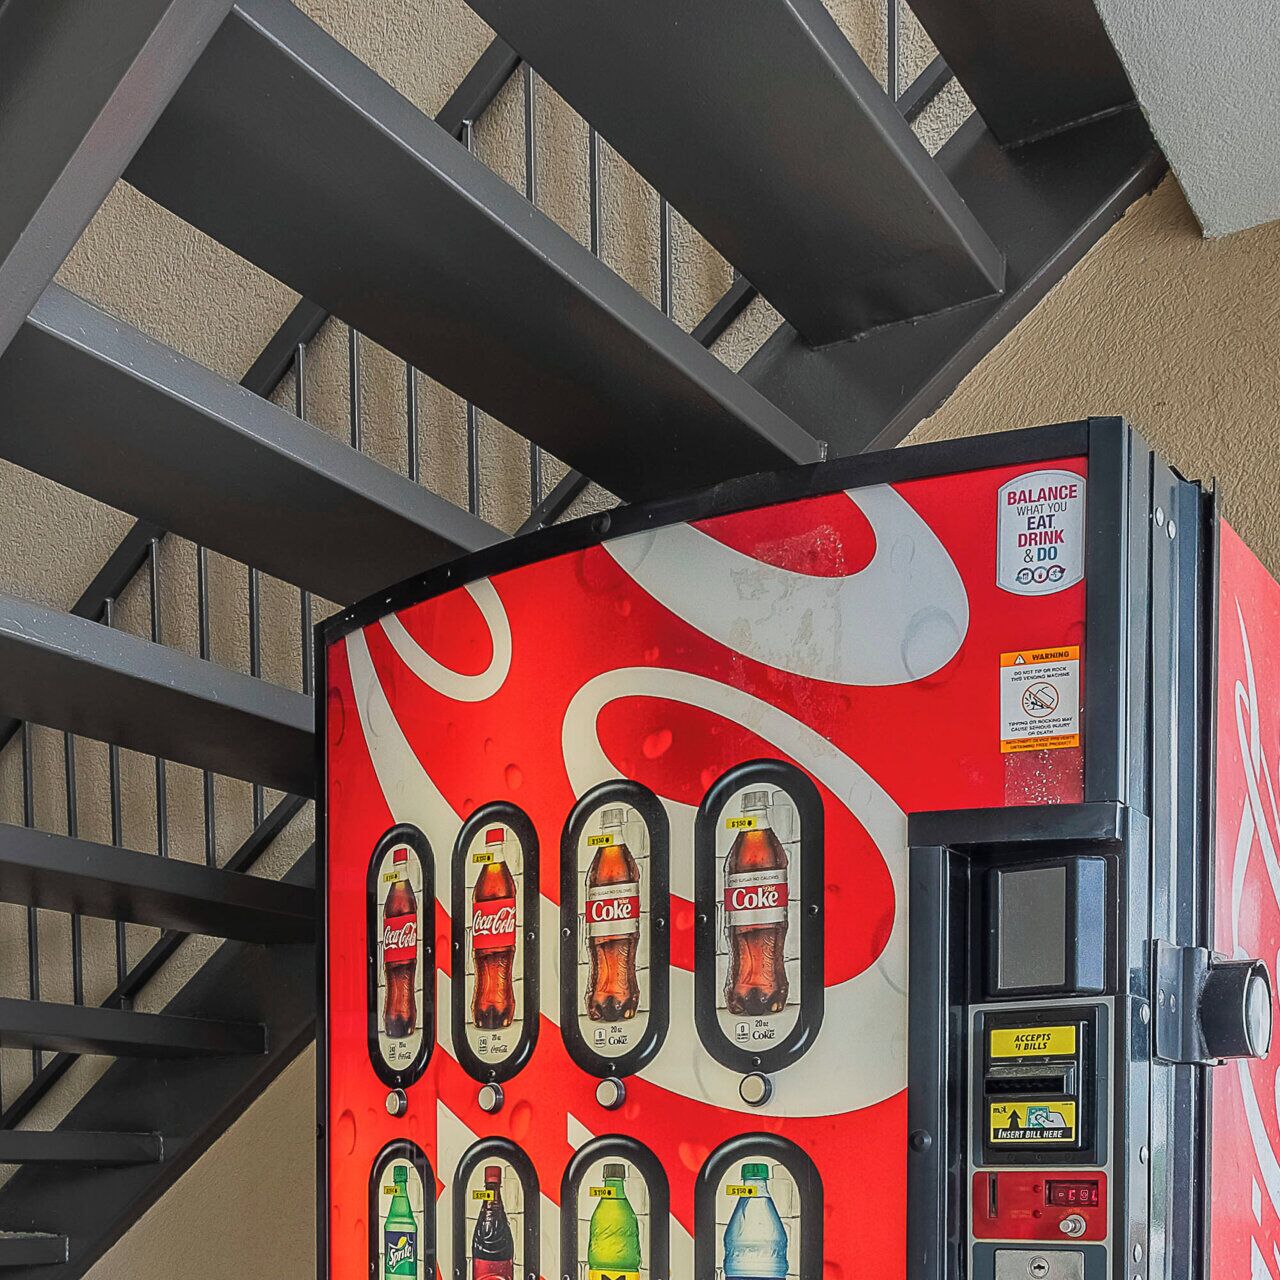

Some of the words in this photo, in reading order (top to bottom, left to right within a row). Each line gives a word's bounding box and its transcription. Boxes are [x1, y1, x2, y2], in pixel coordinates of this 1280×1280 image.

[1007, 484, 1078, 506] BALANCE
[1017, 503, 1045, 516] WHAT
[1047, 502, 1067, 513] YOU
[1018, 529, 1065, 548] DRINK
[1023, 549, 1034, 563] &
[1037, 546, 1058, 561] DO
[1032, 651, 1070, 661] WARNING
[732, 887, 779, 910] Coke
[592, 900, 632, 921] Coke
[472, 907, 516, 936] Coca-Cola
[384, 922, 417, 950] Coca-Cola
[755, 1019, 763, 1028] 20
[608, 1036, 628, 1045] Coke
[752, 1030, 775, 1040] Coke
[1014, 1033, 1051, 1043] ACCEPTS
[1023, 1042, 1048, 1051] BILLS
[1025, 1130, 1042, 1139] BILL
[1043, 1129, 1064, 1139] HERE
[388, 1245, 412, 1267] Sprite
